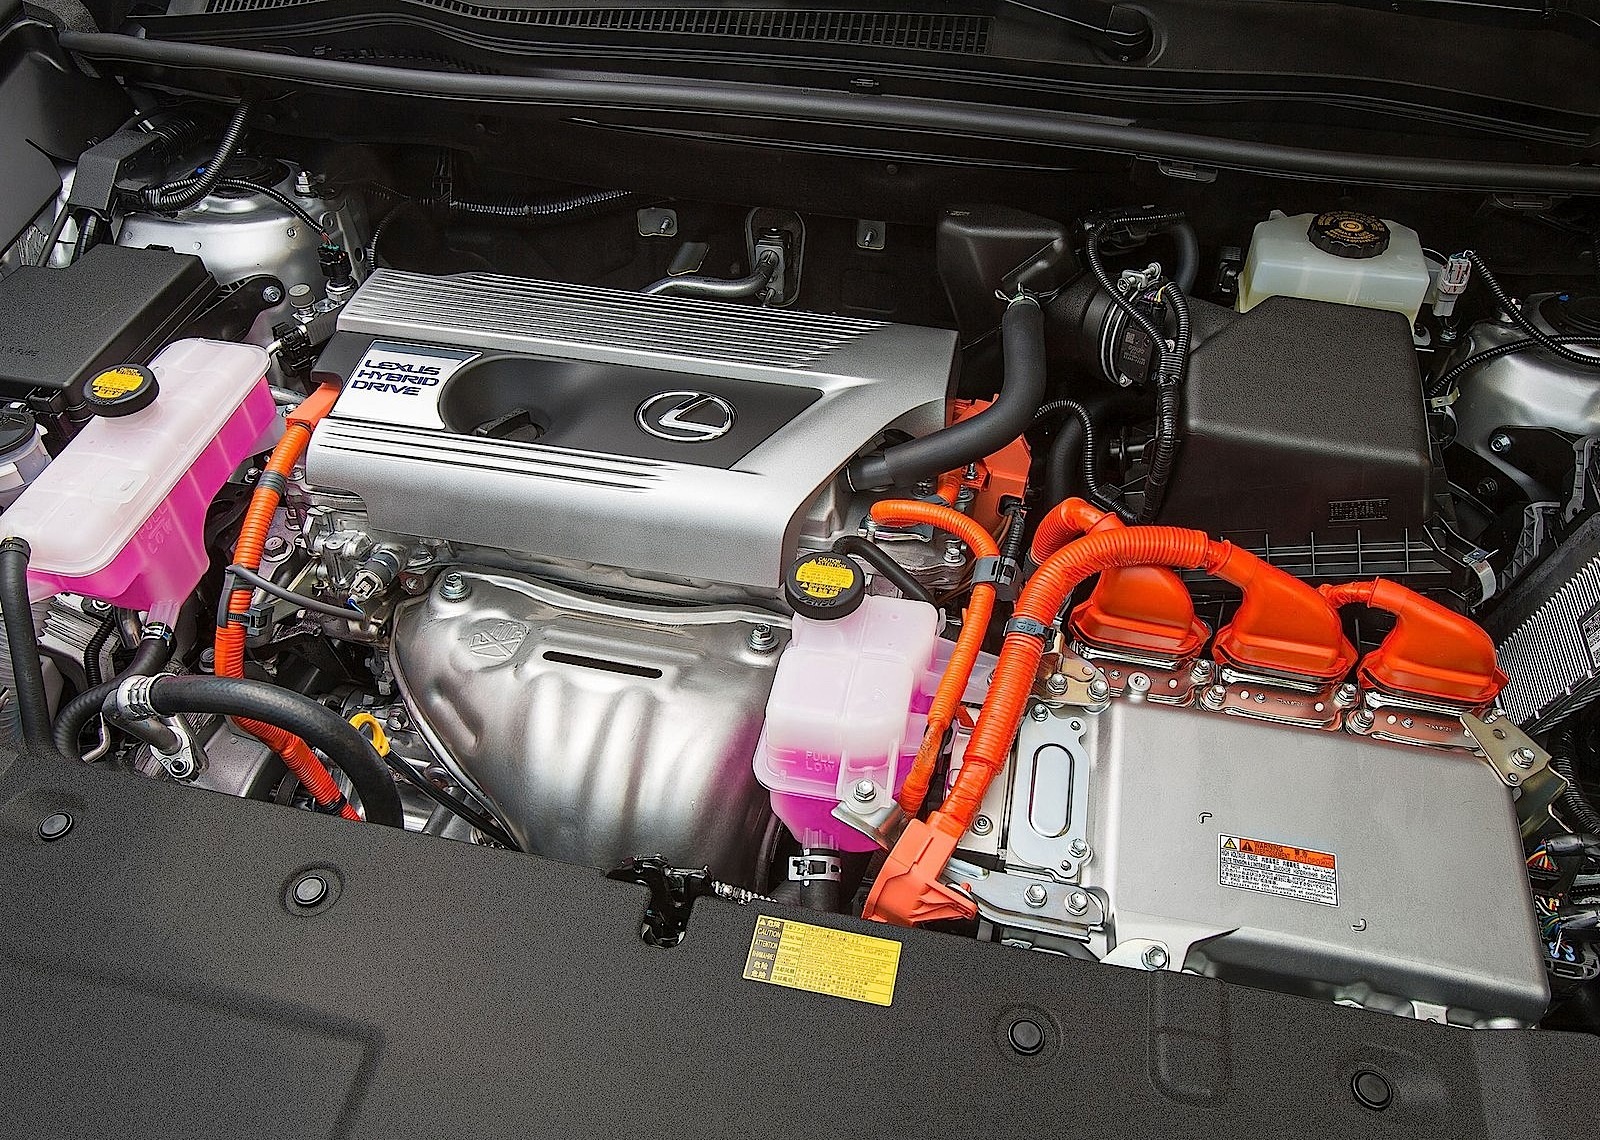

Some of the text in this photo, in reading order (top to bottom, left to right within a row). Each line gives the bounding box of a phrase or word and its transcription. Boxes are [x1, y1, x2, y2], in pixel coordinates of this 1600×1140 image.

[365, 359, 441, 376] LEXUS
[357, 370, 440, 386] HYBRID
[351, 380, 421, 396] DRIVE
[806, 751, 835, 764] FULL
[757, 927, 781, 938] CAUTION
